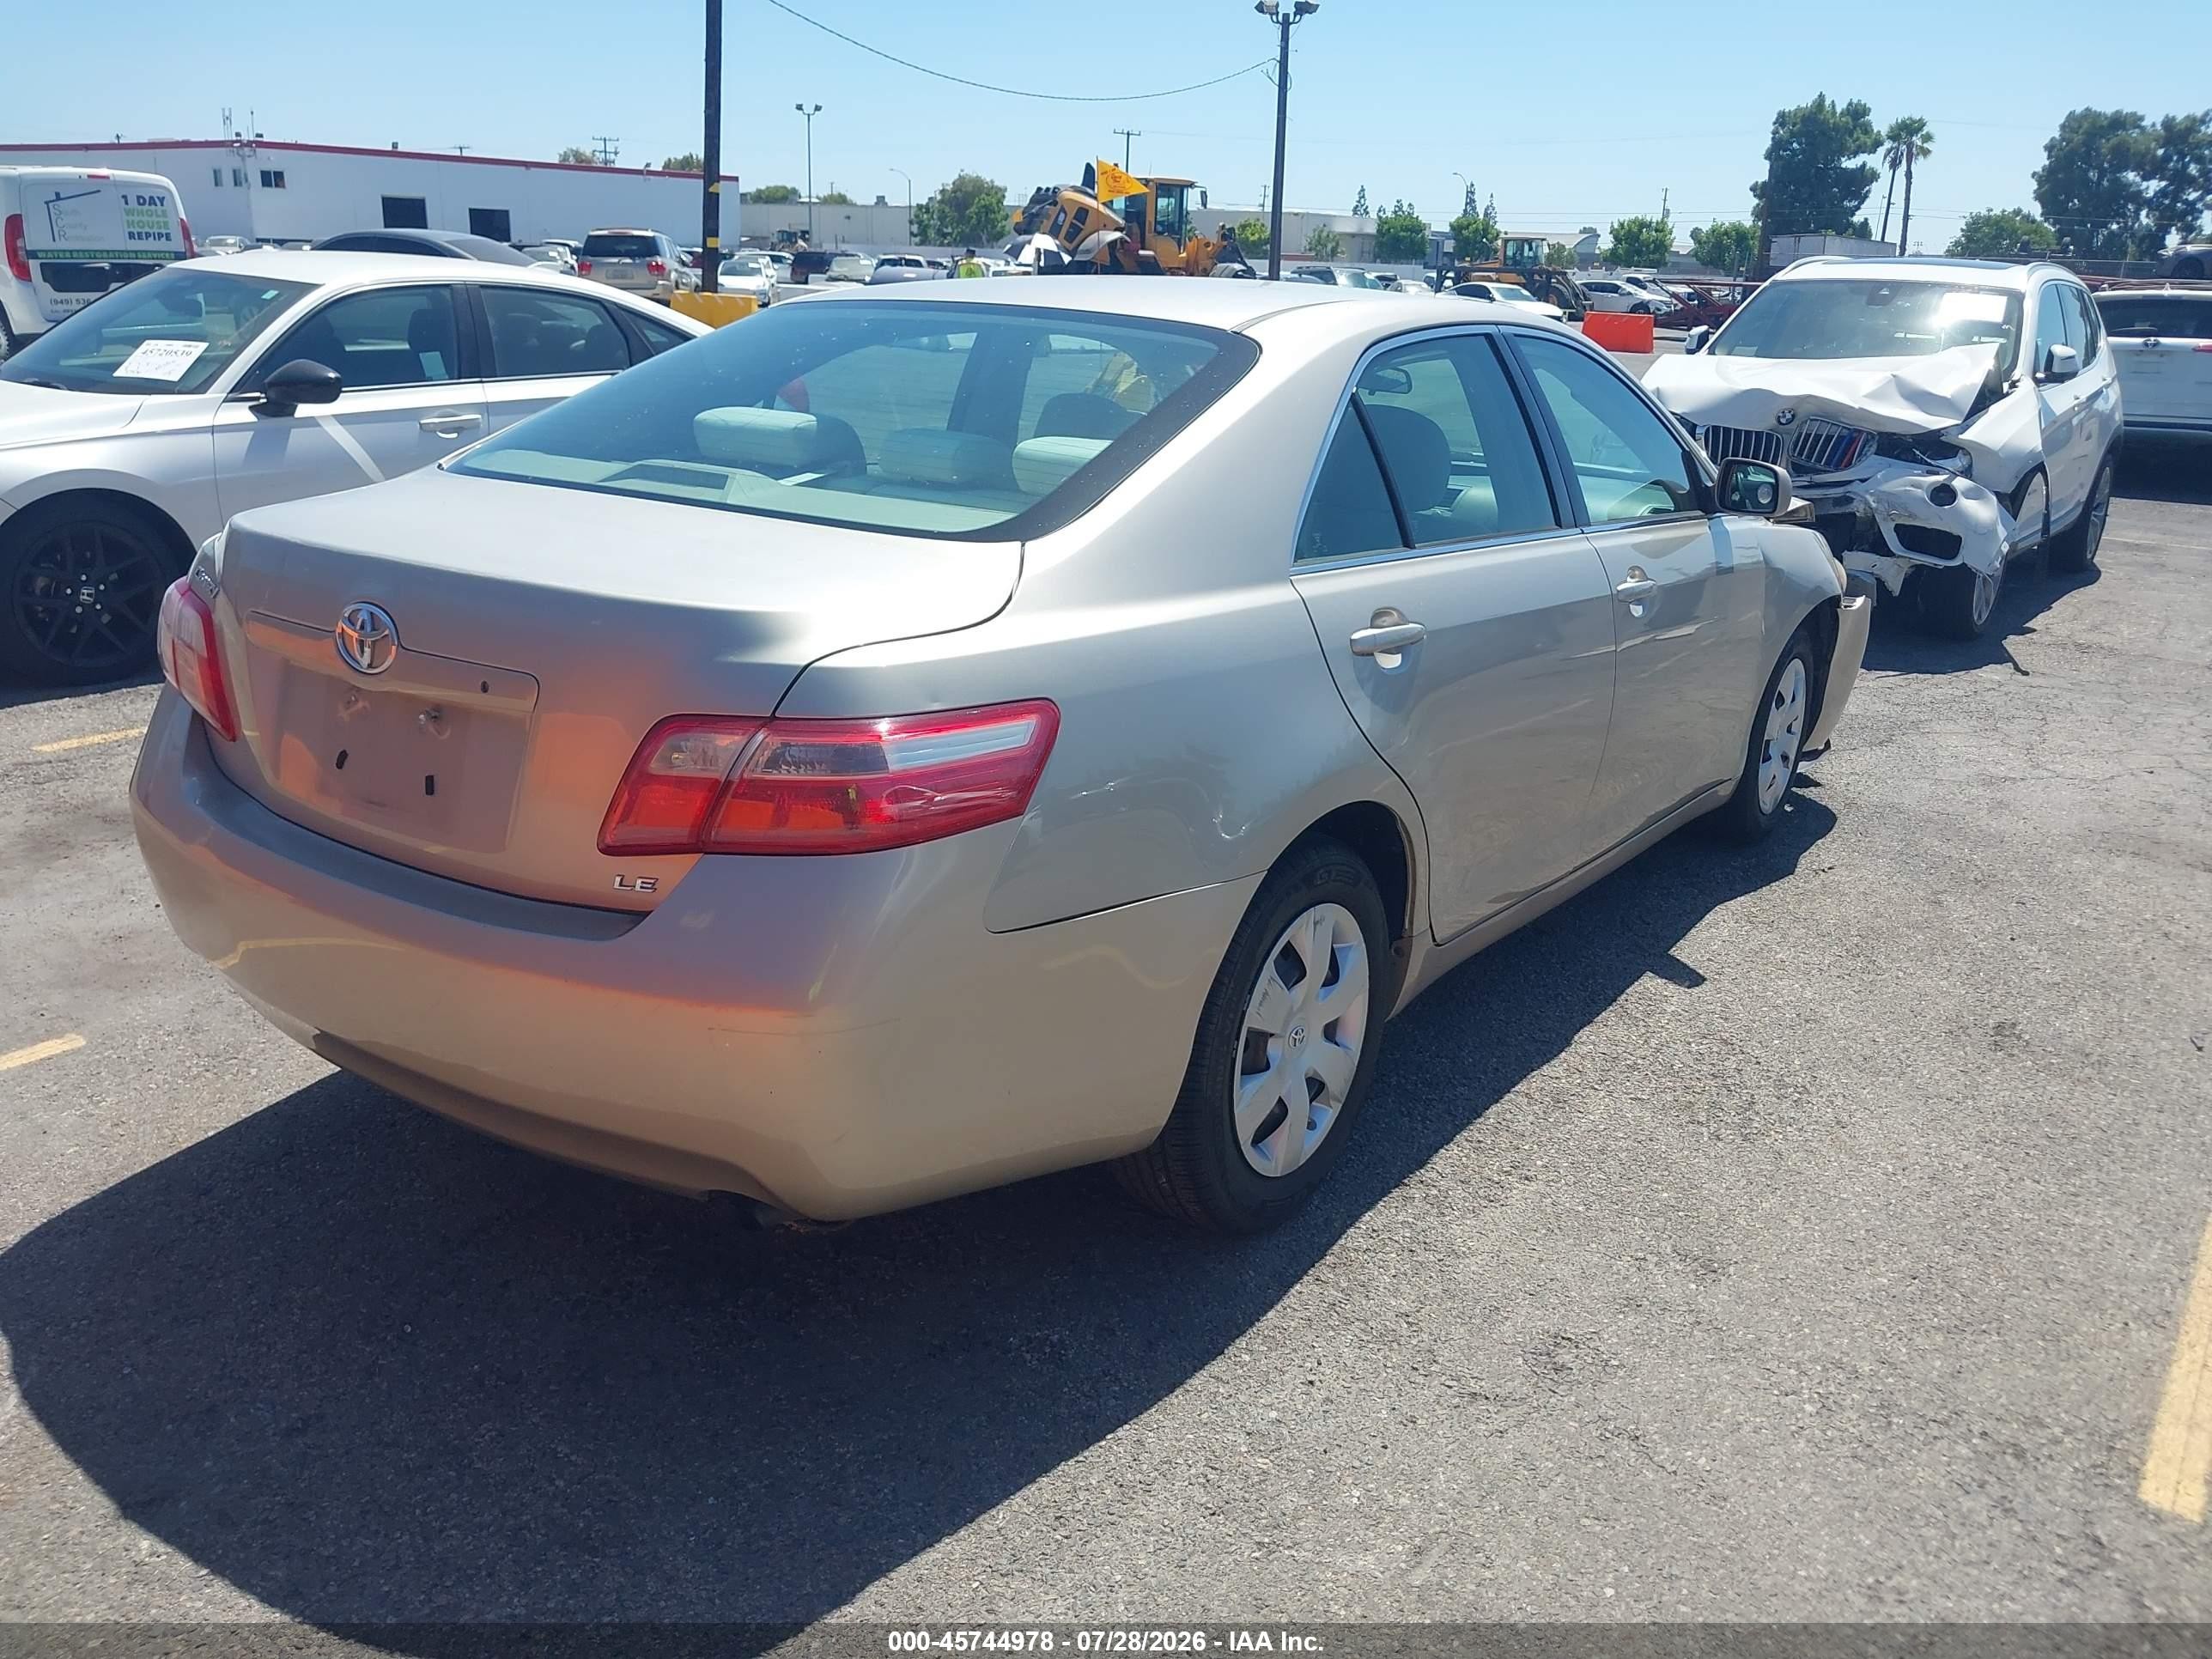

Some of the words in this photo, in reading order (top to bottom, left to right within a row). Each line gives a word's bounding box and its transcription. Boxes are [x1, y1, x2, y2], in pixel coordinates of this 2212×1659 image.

[121, 194, 129, 206] 1
[136, 195, 166, 207] DAY
[124, 207, 168, 218] WHOLE
[126, 219, 170, 230] HOUSE
[128, 230, 173, 241] REPIPE
[72, 251, 136, 259] RESTORATION
[613, 874, 659, 893] LE
